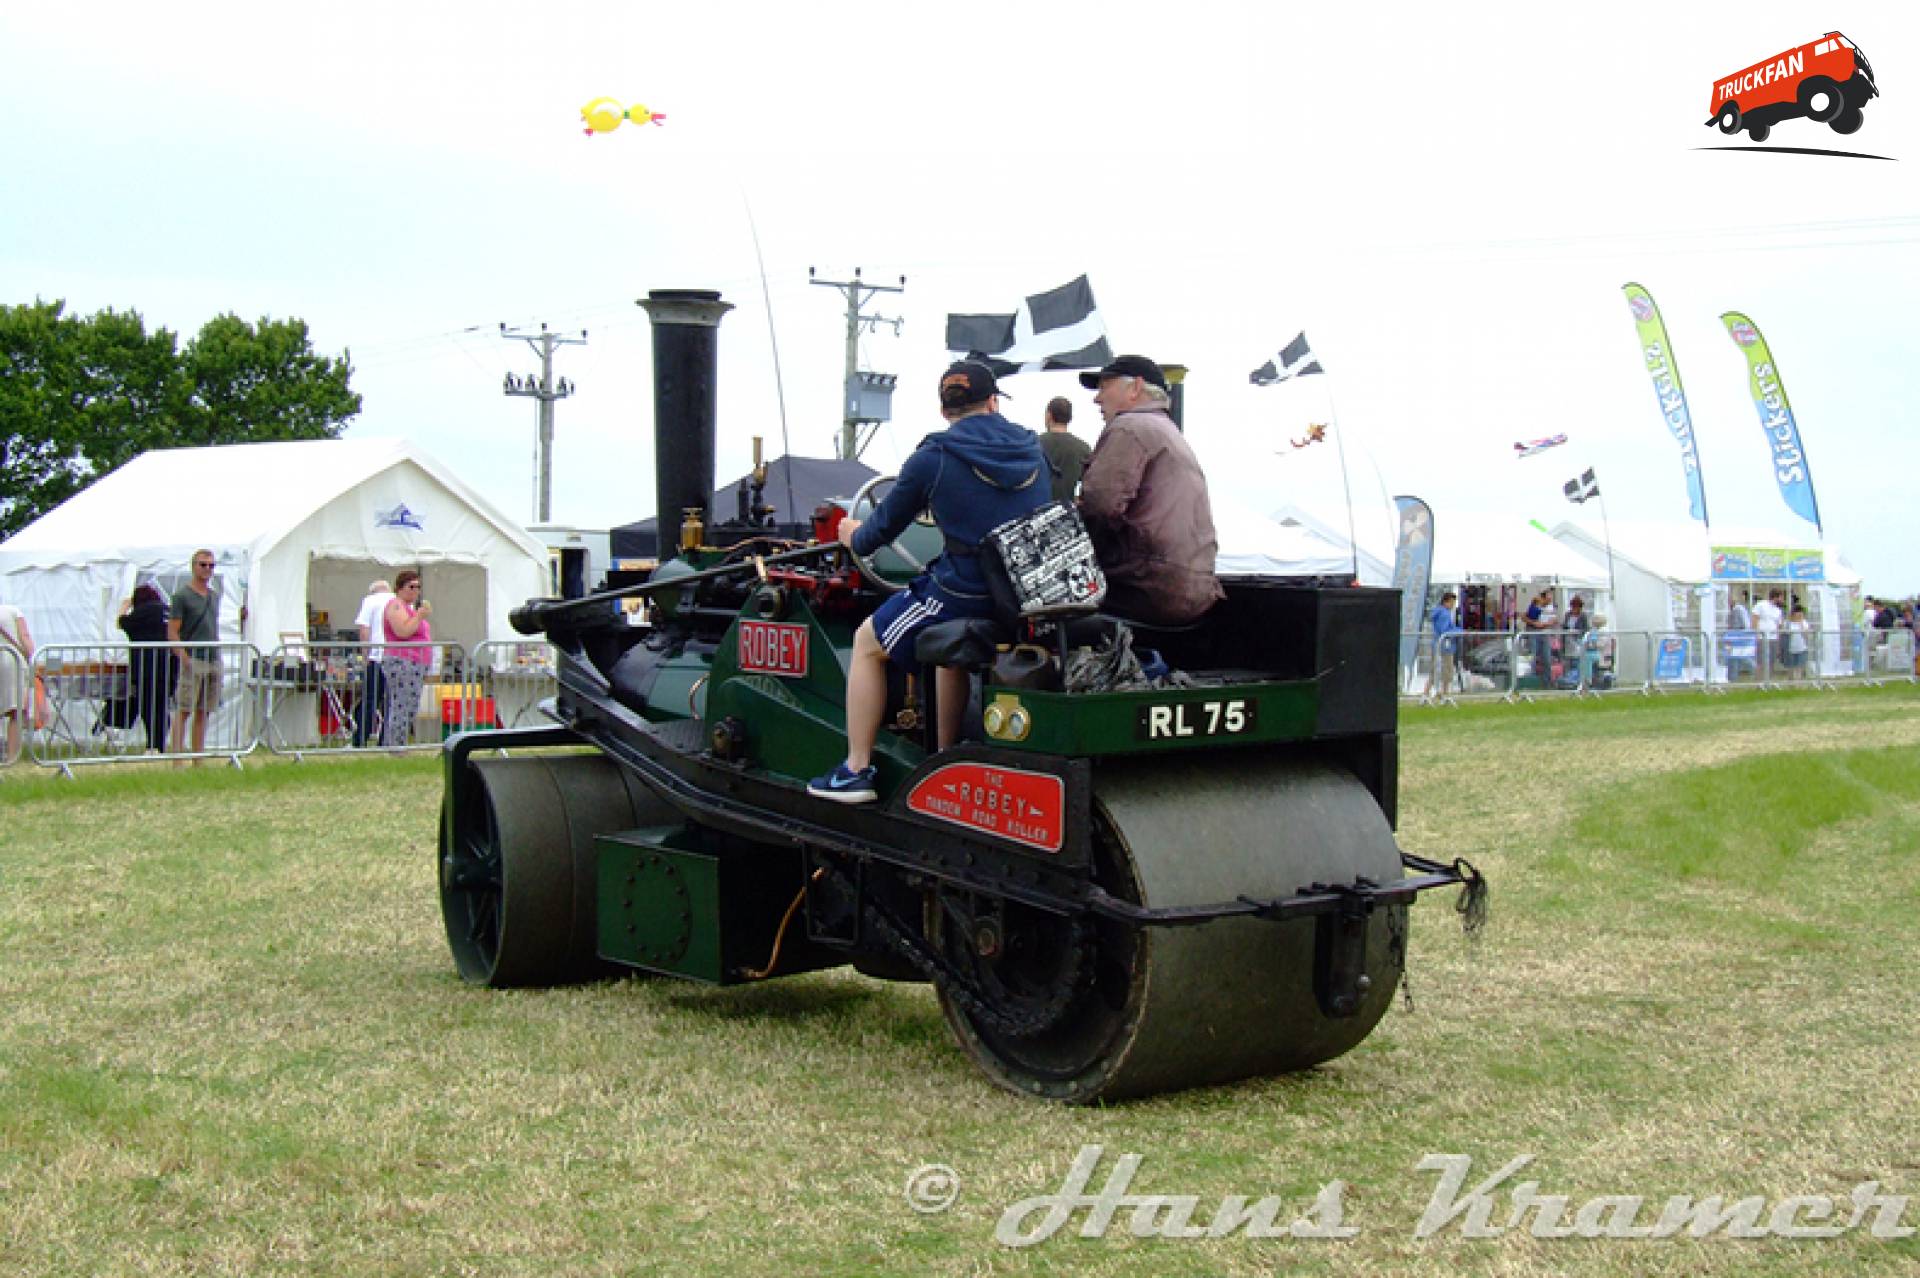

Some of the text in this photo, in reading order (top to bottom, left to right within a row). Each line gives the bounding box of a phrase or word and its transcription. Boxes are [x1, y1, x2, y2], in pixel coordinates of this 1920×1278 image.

[1754, 362, 1805, 484] Stickers
[741, 623, 803, 671] ROBEY
[1149, 700, 1246, 738] RL 75
[984, 771, 1004, 787] THE
[960, 782, 1026, 817] ROBEY
[972, 809, 997, 827] ROAD
[1008, 819, 1048, 841] ROLLER
